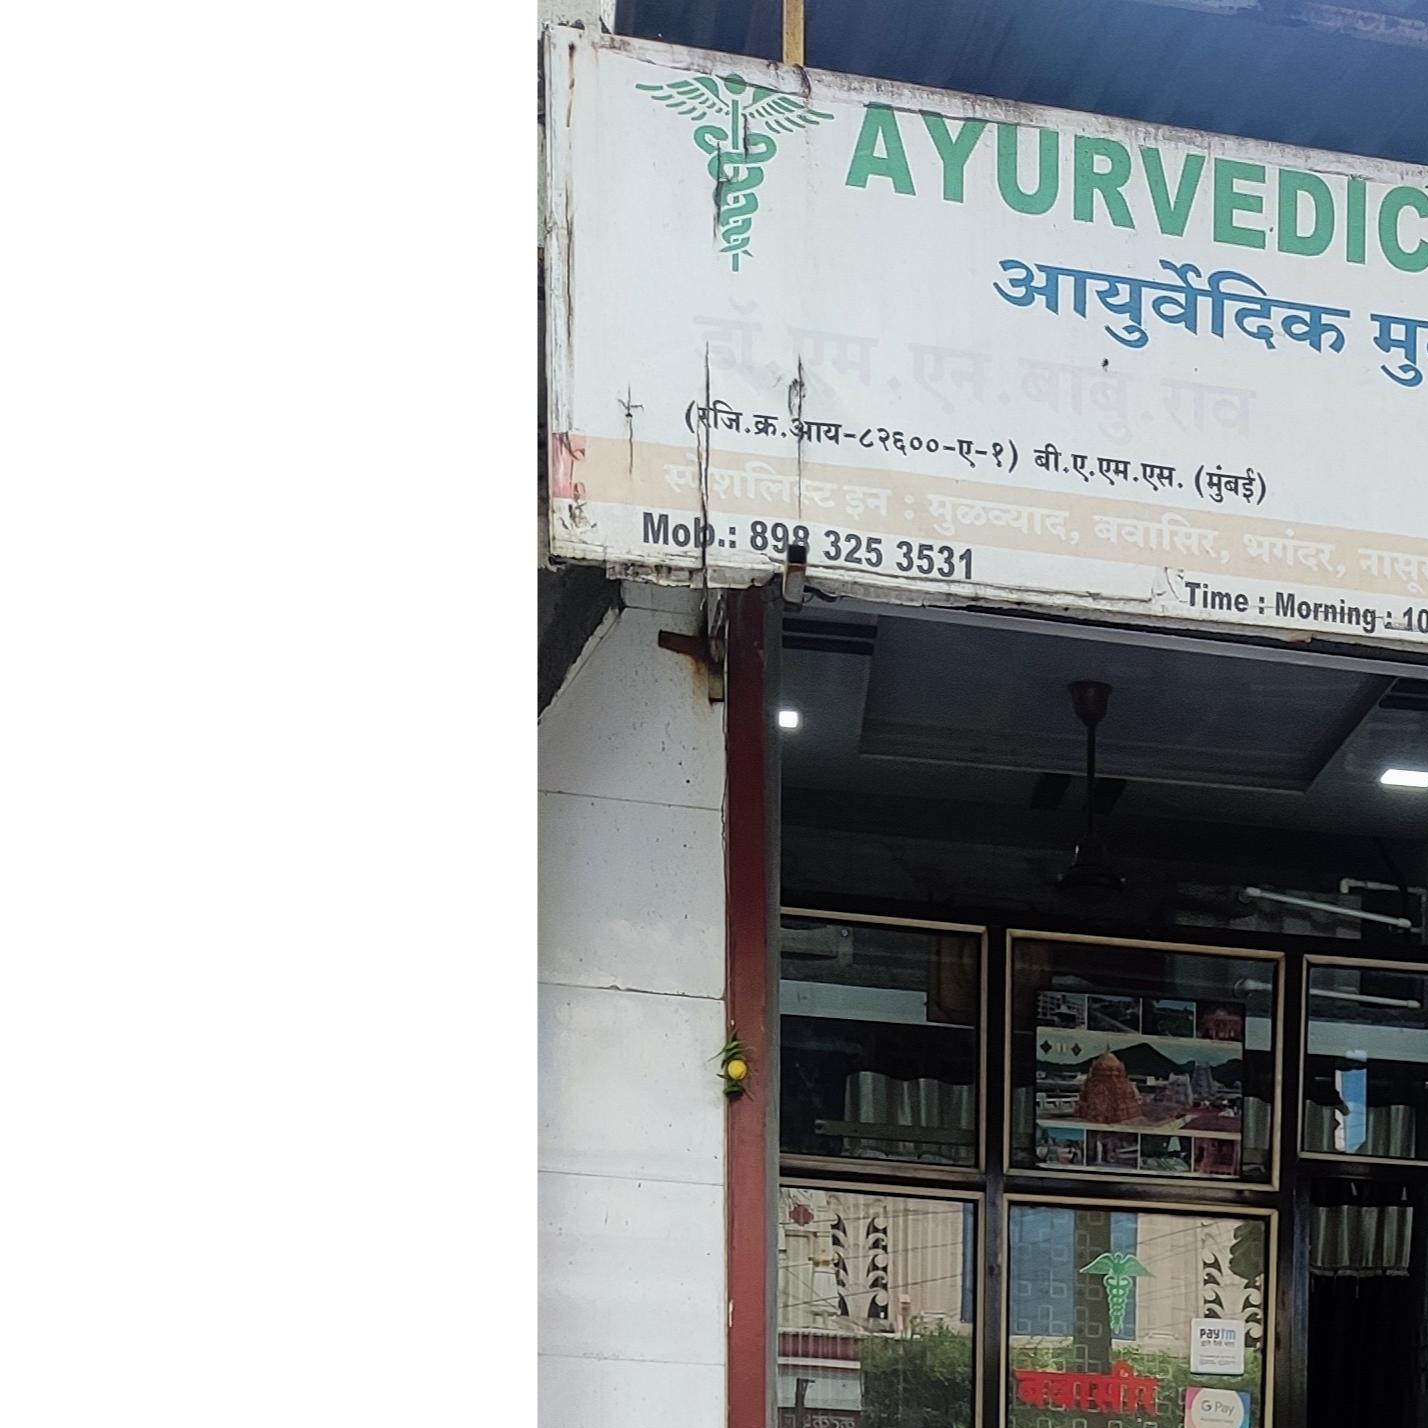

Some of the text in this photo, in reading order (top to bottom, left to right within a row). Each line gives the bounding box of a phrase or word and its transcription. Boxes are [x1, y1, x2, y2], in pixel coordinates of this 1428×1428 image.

[993, 259, 1352, 352] आयुर्वेदिक
[844, 484, 890, 520] इन
[1195, 465, 1266, 505] (मुंबई)
[643, 511, 972, 580] Mob.: 898 325 3531
[1185, 582, 1249, 612] Time
[1276, 592, 1377, 633] Morning
